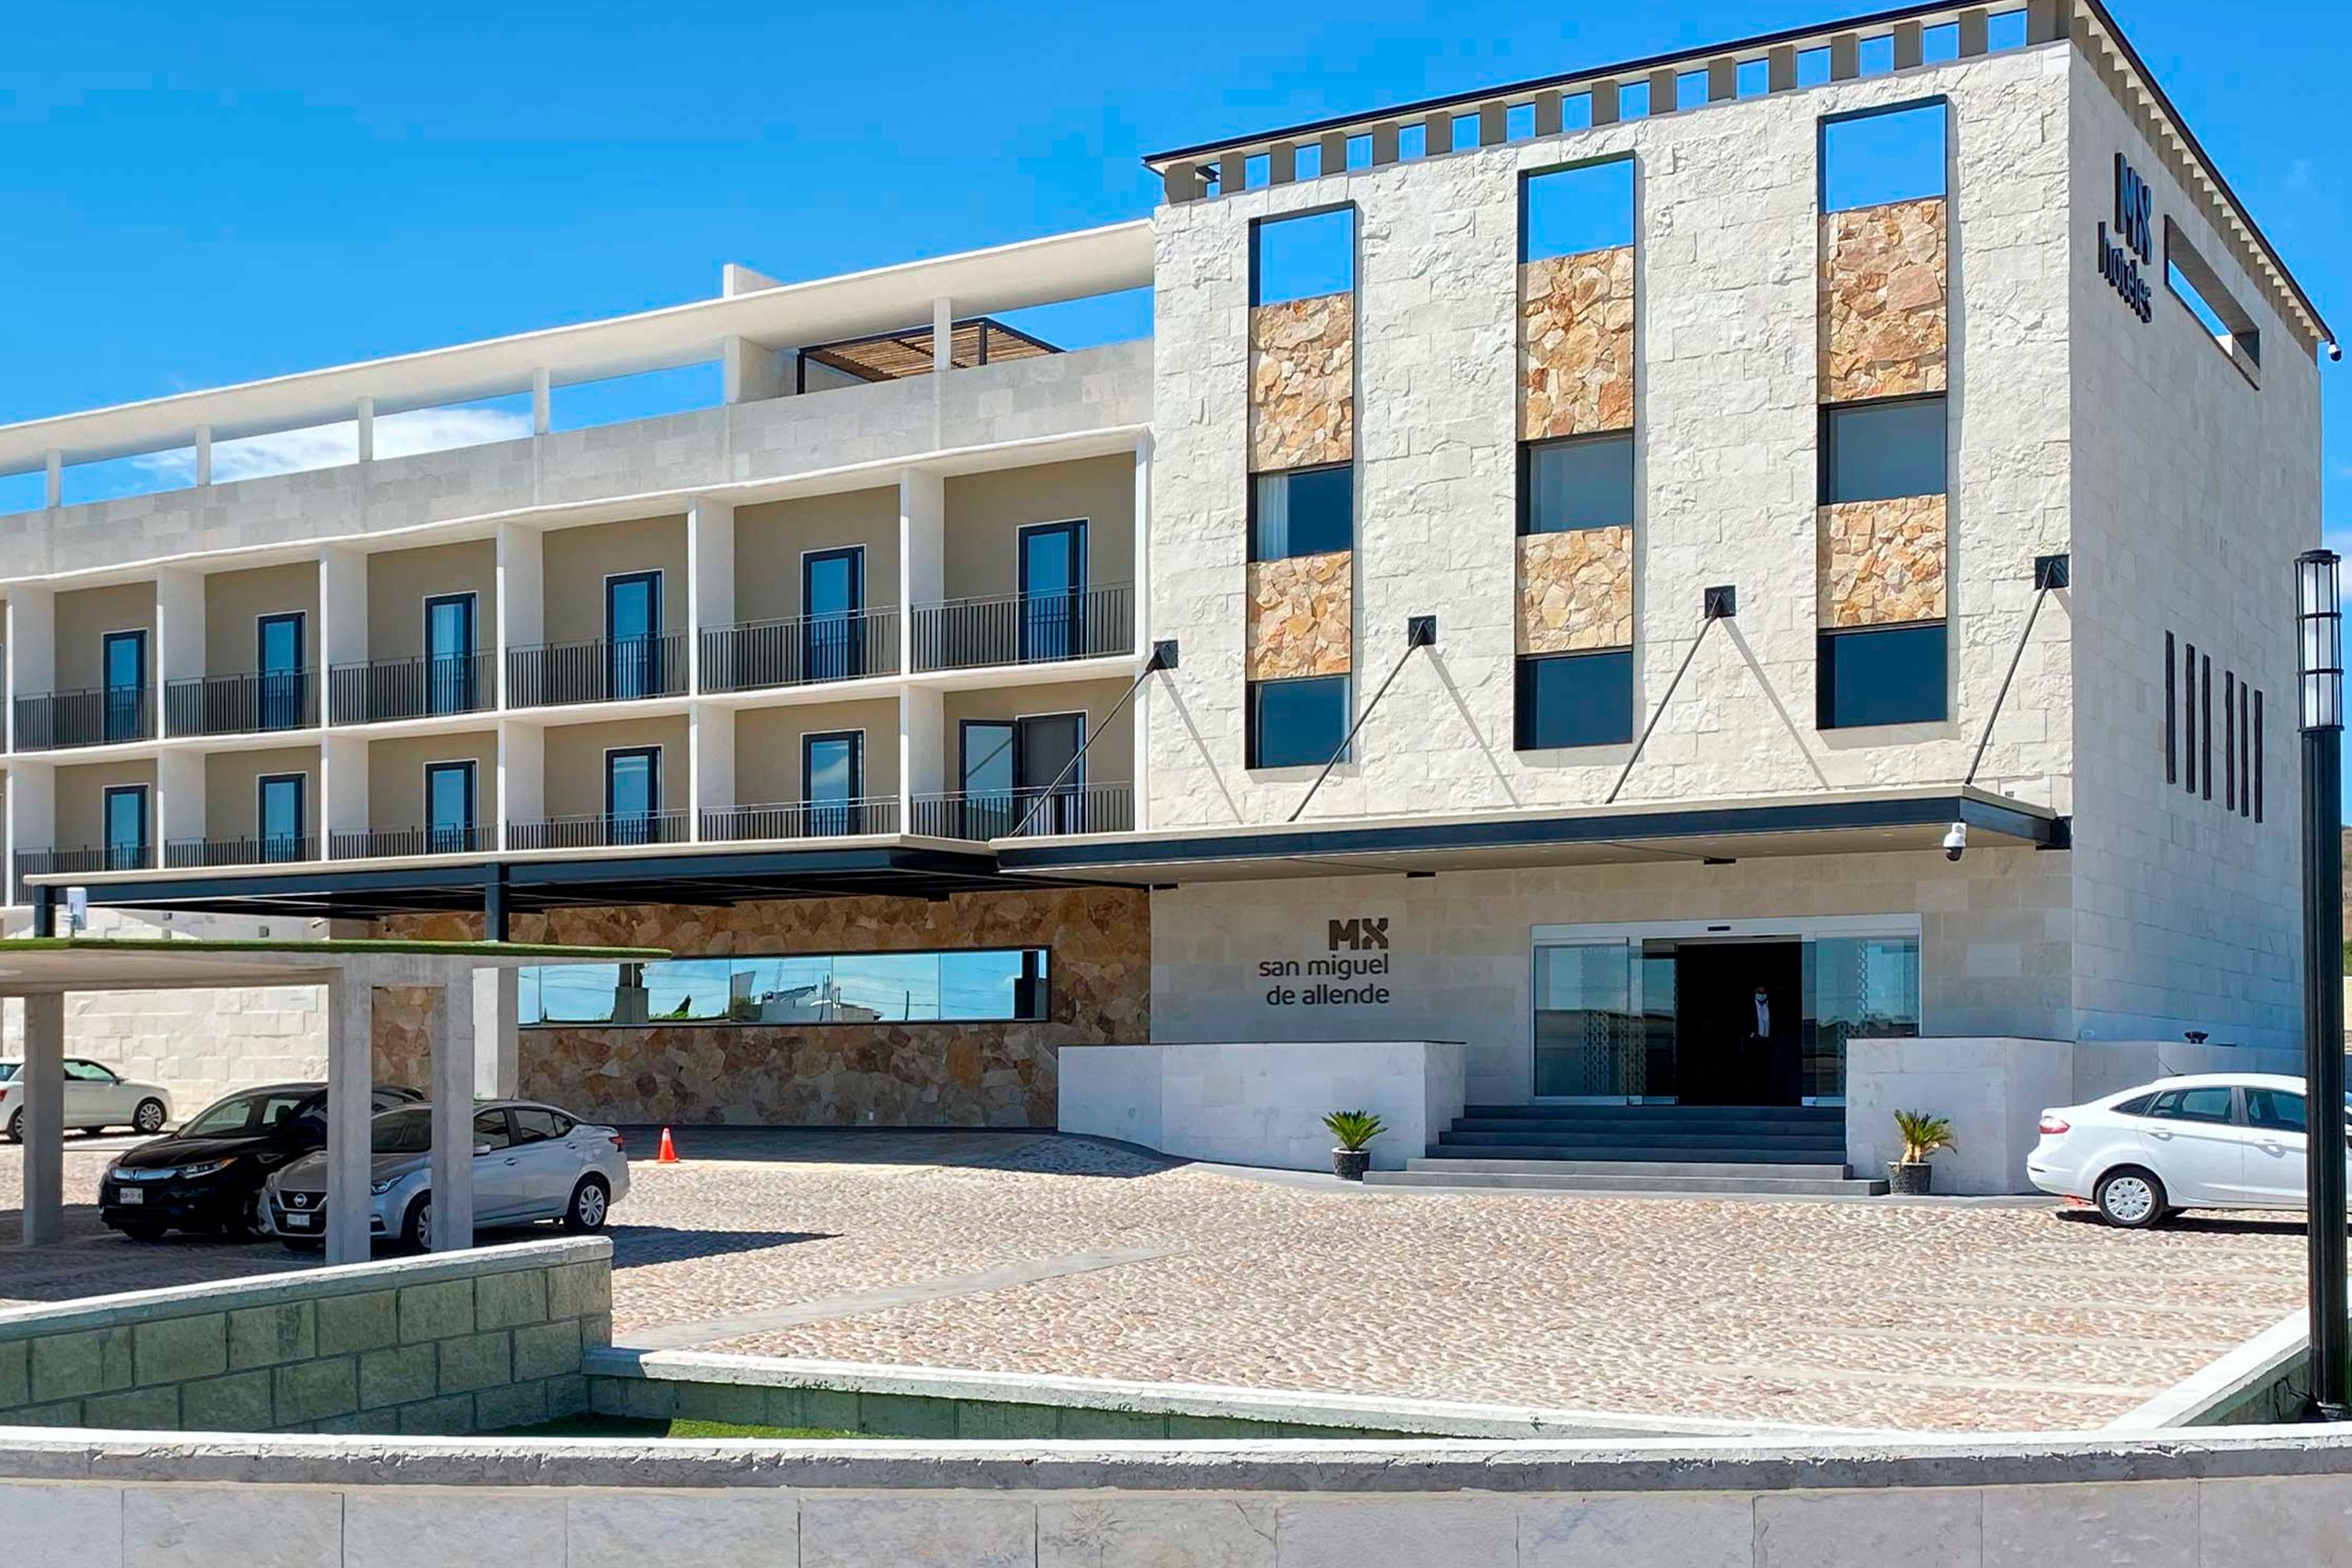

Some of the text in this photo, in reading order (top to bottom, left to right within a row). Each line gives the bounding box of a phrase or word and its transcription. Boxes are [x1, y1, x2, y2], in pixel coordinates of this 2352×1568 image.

[2114, 153, 2152, 266] MX
[2098, 222, 2151, 323] hotels
[1329, 918, 1388, 950] MX
[1259, 953, 1388, 980] san miguel
[1266, 983, 1389, 1005] de allende
